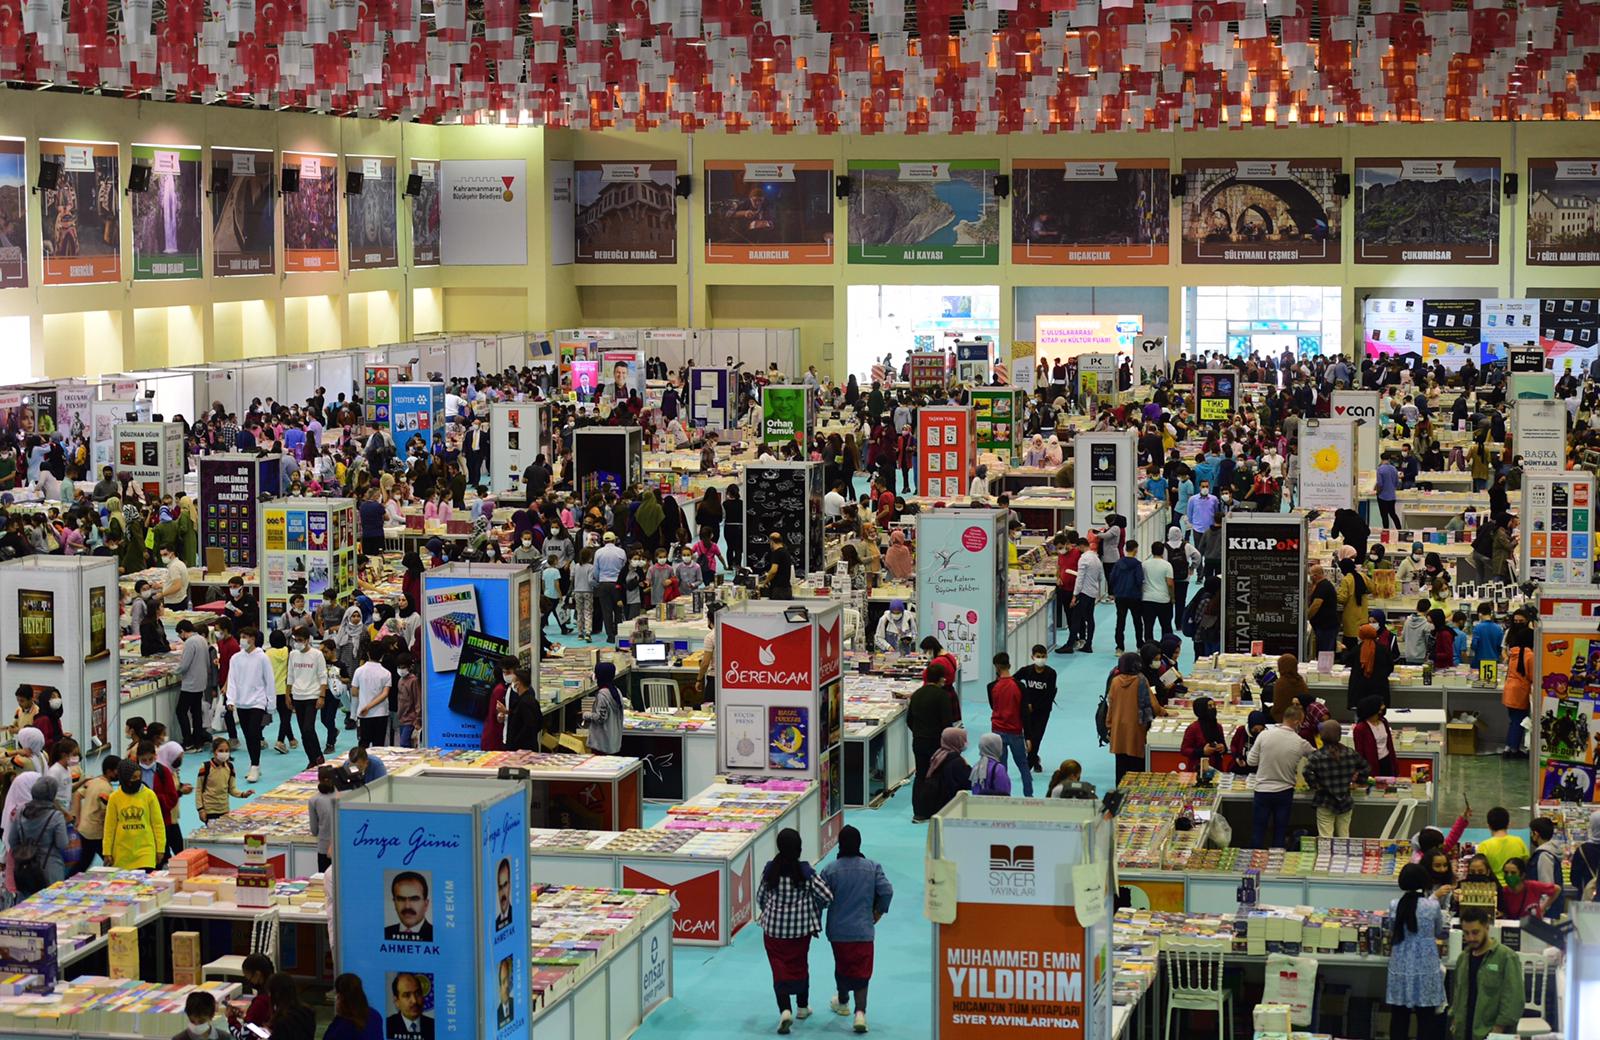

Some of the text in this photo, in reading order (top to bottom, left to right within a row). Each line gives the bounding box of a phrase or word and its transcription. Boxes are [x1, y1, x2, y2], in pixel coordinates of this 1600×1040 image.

[916, 250, 943, 260] KAYASI
[1346, 406, 1375, 417] can
[766, 420, 793, 428] Orhan
[766, 427, 794, 436] Pamuk
[1524, 449, 1557, 459] BAŞKA
[1260, 573, 1286, 581] TÜRLER
[1255, 613, 1285, 623] Masal
[467, 635, 500, 652] MARIE
[725, 660, 810, 685] SERENCAM
[1483, 664, 1493, 680] 15
[442, 731, 482, 739] GÜVENECEĞ
[122, 823, 146, 831] QUEEN
[353, 819, 461, 866] İmza Günü
[444, 879, 455, 911] EKİM
[990, 887, 1036, 897] YAYINLARI
[672, 918, 717, 935] NCAM
[379, 943, 441, 956] AHMET AK
[947, 948, 1039, 969] MUHAMMED
[643, 958, 666, 990] ensar
[947, 967, 1082, 1003] YILDIRIM
[446, 984, 457, 1018] EKİM
[952, 1001, 1006, 1015] HOCAMIZIN
[1008, 1003, 1029, 1015] TÜM
[989, 1015, 1080, 1030] YAYINLARI'NDA
